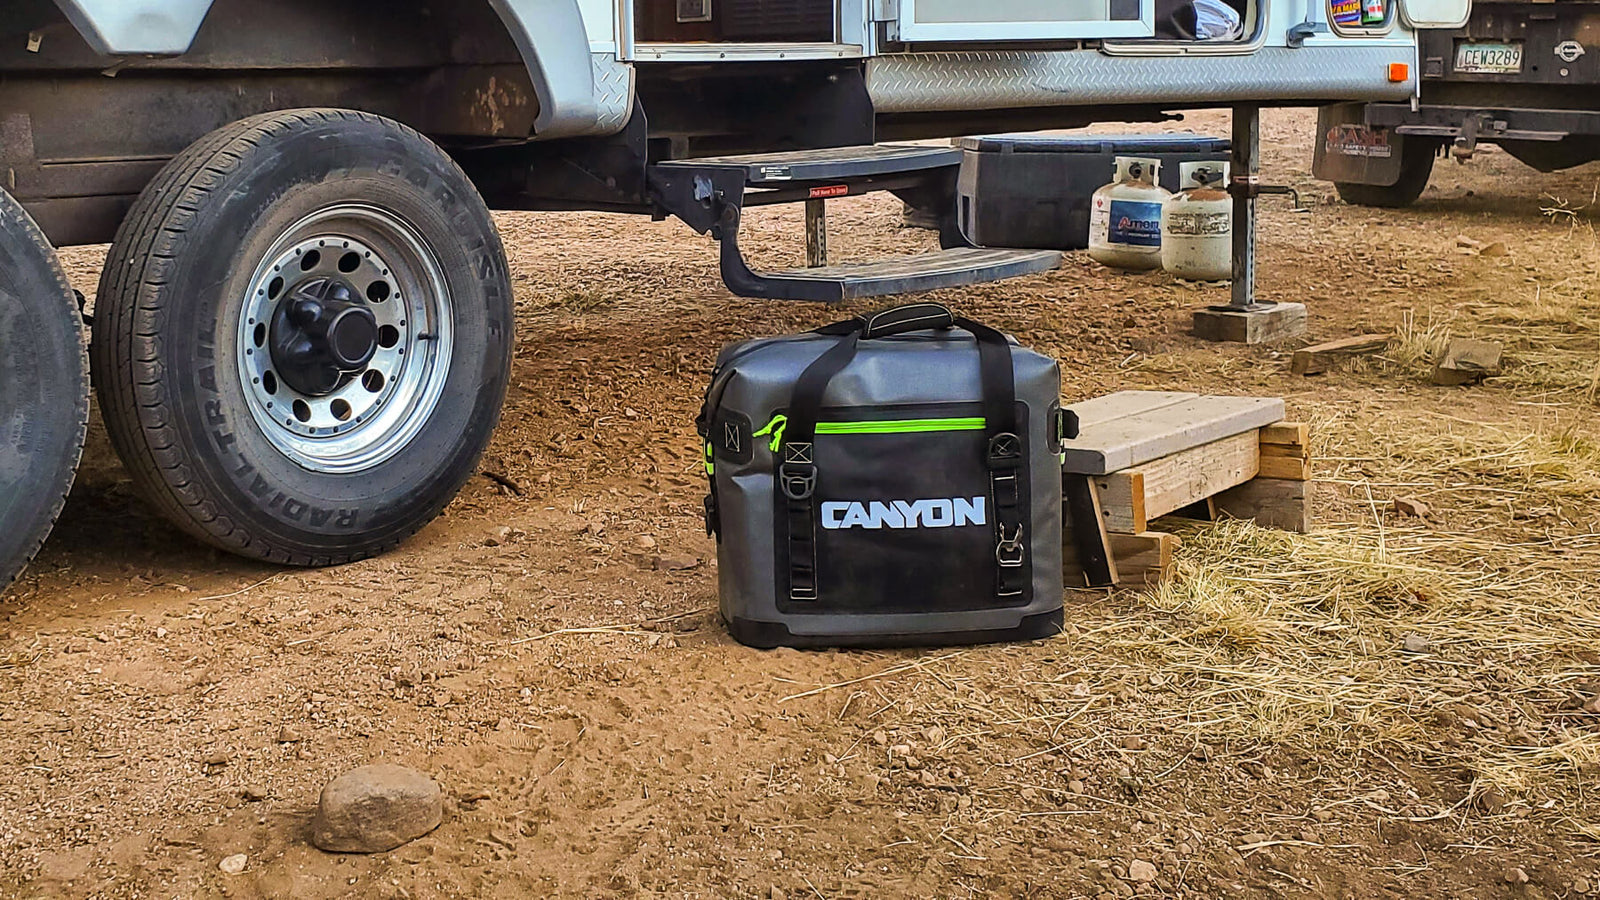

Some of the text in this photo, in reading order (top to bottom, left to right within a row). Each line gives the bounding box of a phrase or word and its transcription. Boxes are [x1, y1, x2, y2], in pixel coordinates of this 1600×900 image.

[1464, 50, 1520, 66] CEW3289
[196, 319, 359, 529] RADIAL TRAIL
[821, 496, 986, 530] CANYON
